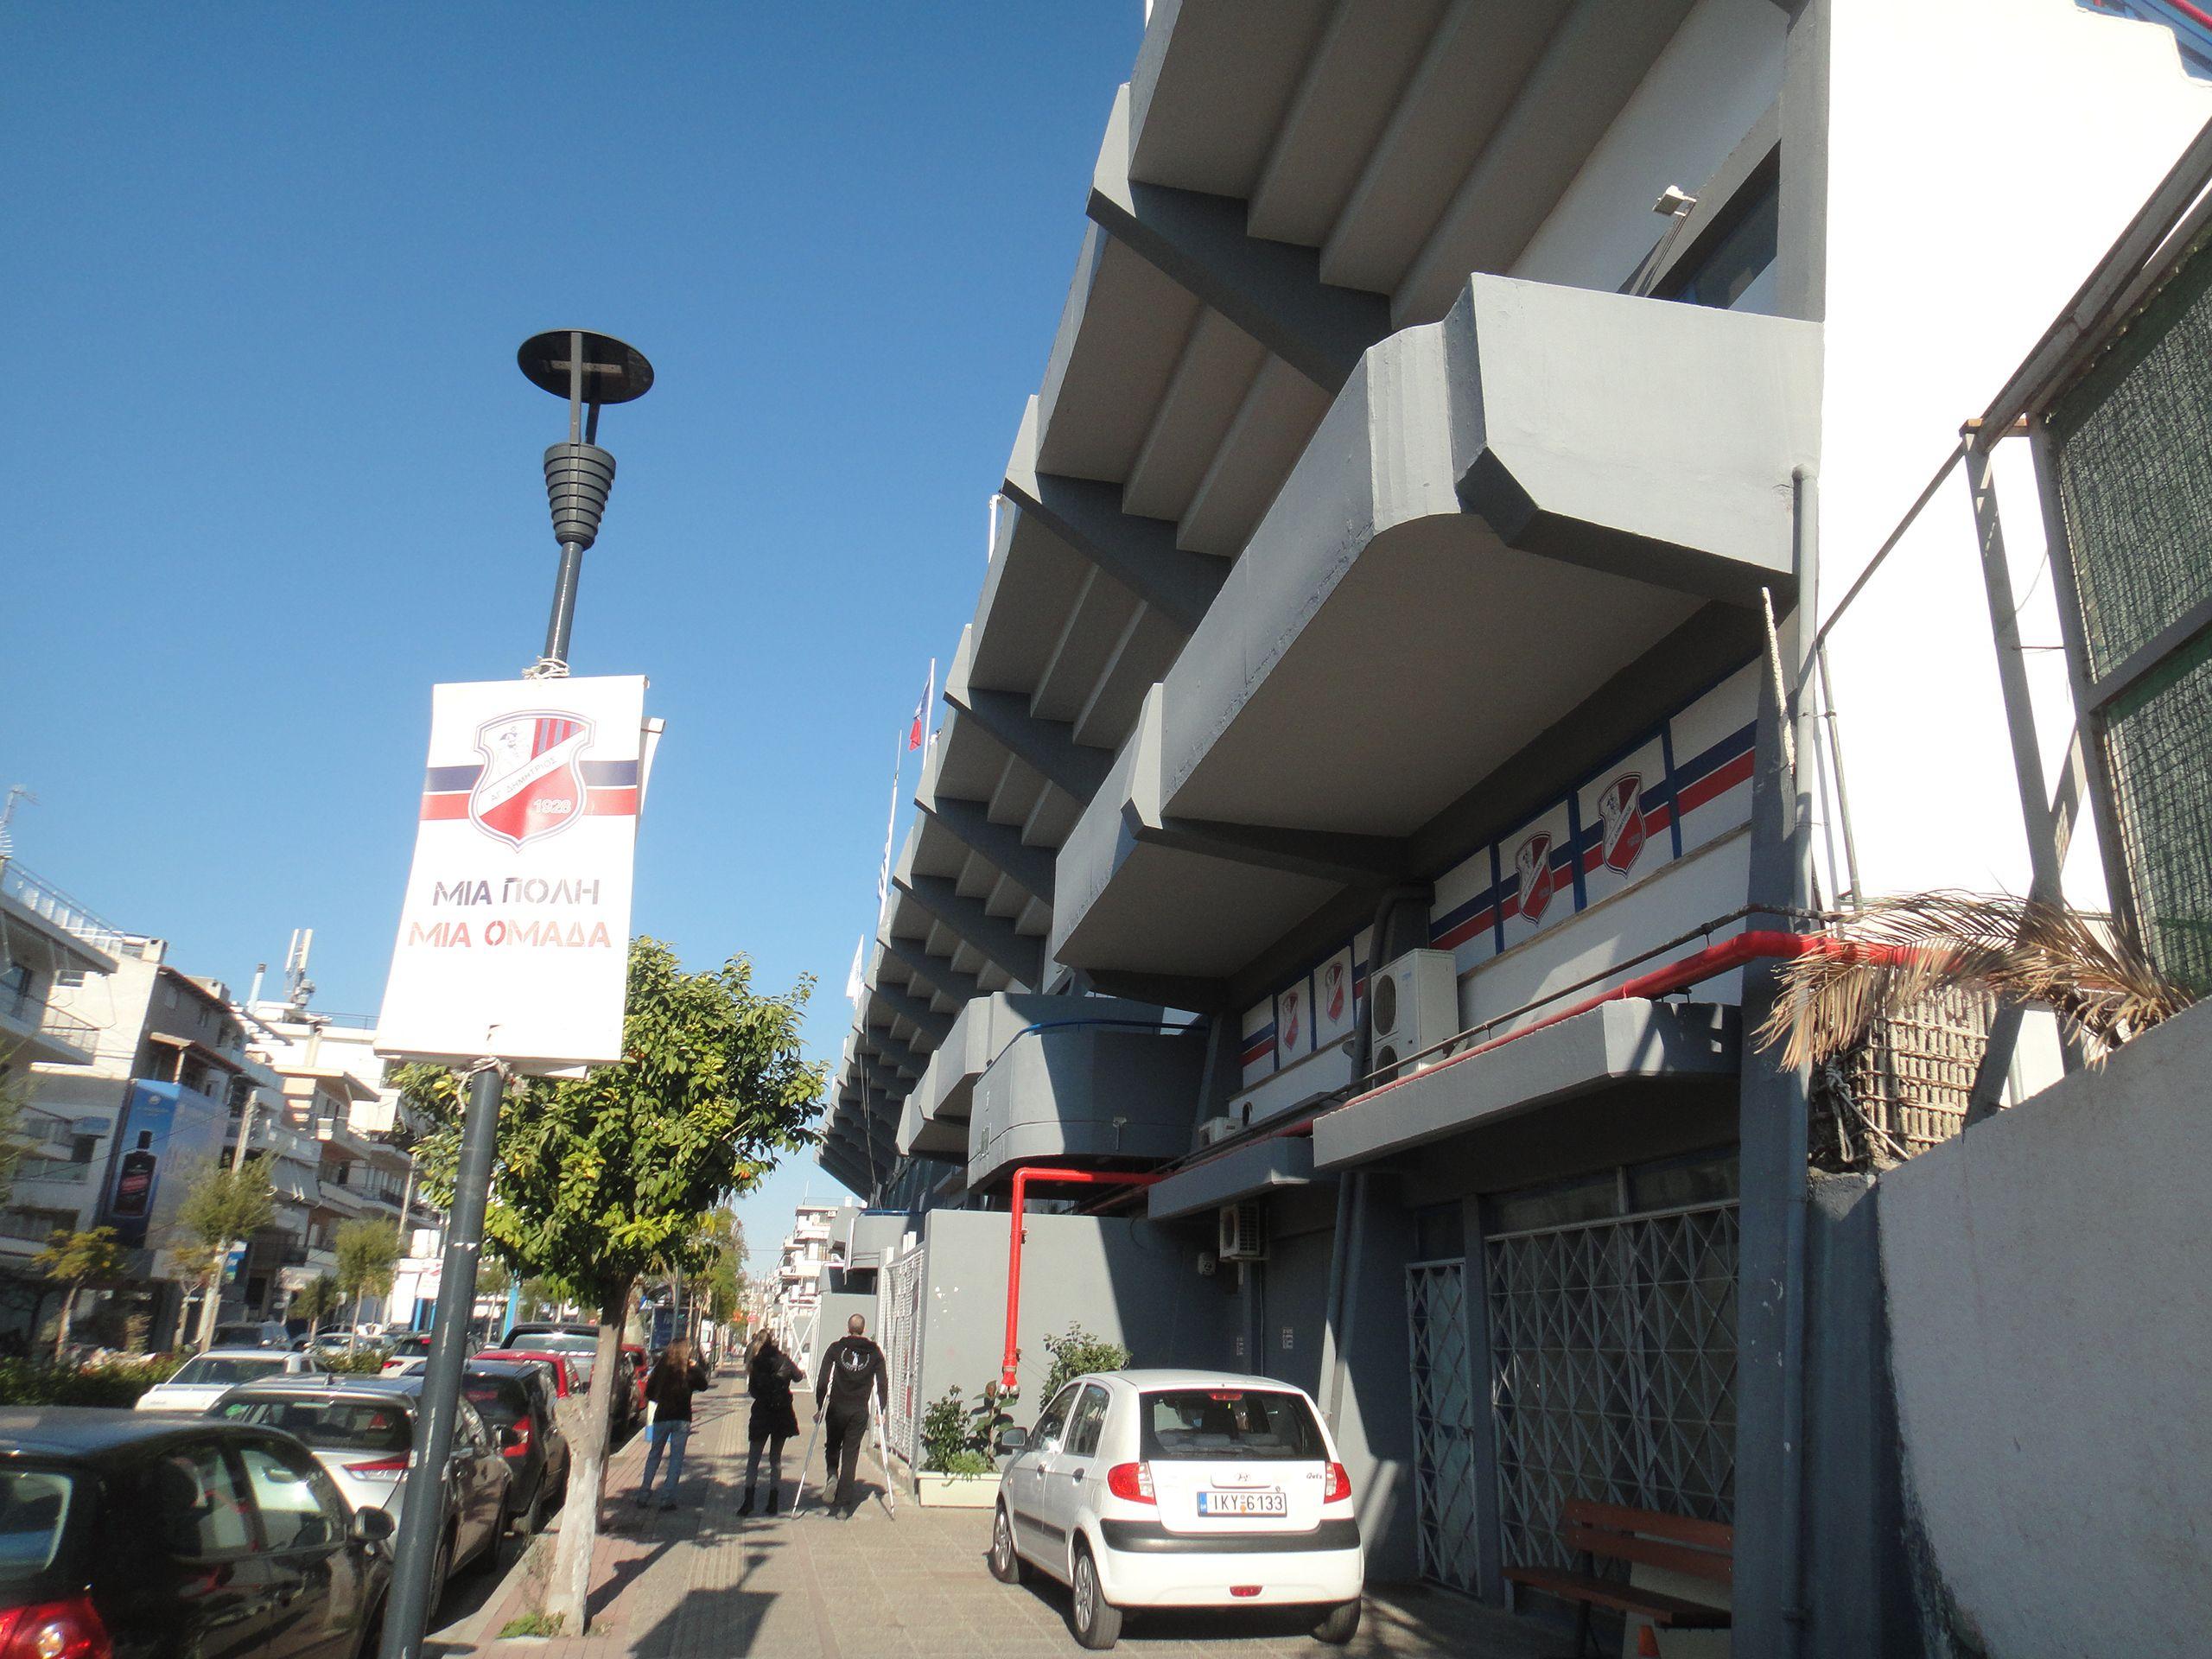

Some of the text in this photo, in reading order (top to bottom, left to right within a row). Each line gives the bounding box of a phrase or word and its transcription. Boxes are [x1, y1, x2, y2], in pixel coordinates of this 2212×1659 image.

[534, 798, 572, 813] 1928
[433, 877, 600, 906] ΜΙΑ ΠΟΛΗ
[408, 919, 612, 948] ΜΙΑ ΟΜΑΔΑ
